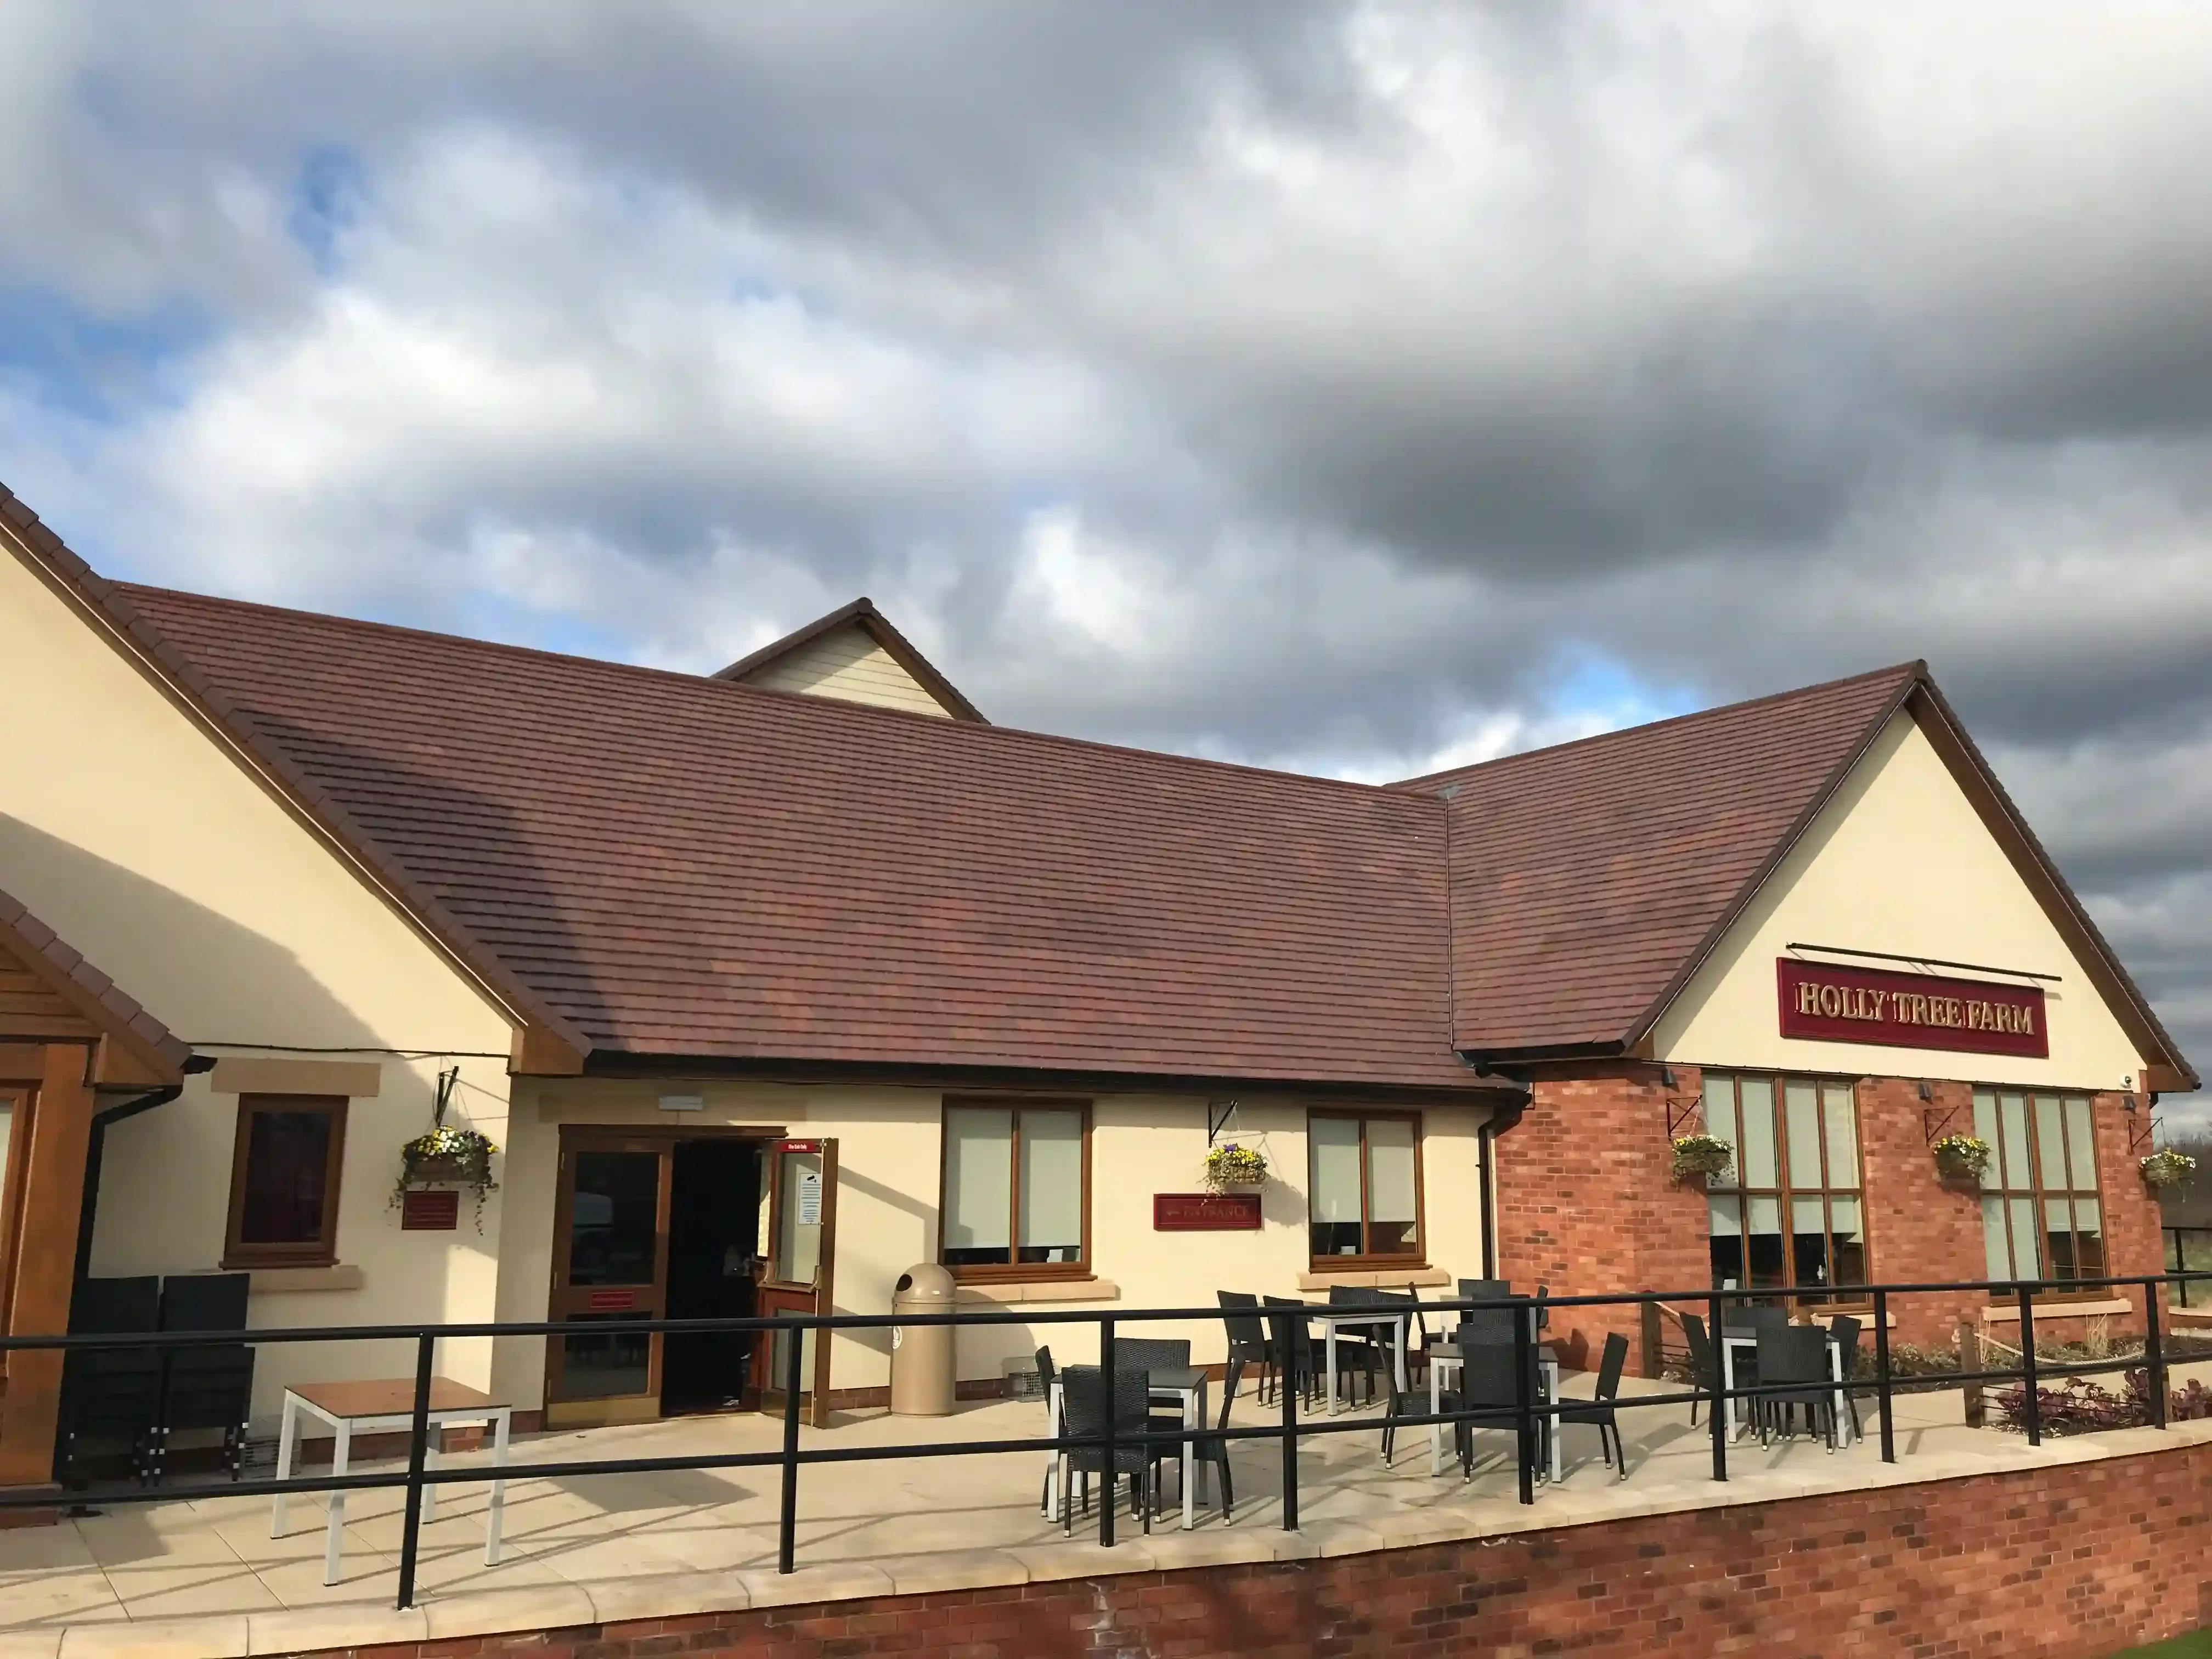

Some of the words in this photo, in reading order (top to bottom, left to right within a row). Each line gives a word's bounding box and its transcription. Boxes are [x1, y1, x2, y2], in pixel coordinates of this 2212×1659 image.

[1798, 981, 1886, 1022] HOLLY
[1893, 992, 1962, 1029] TREE
[1966, 1000, 2035, 1035] FARM
[1183, 1205, 1249, 1217] ENTRANCE
